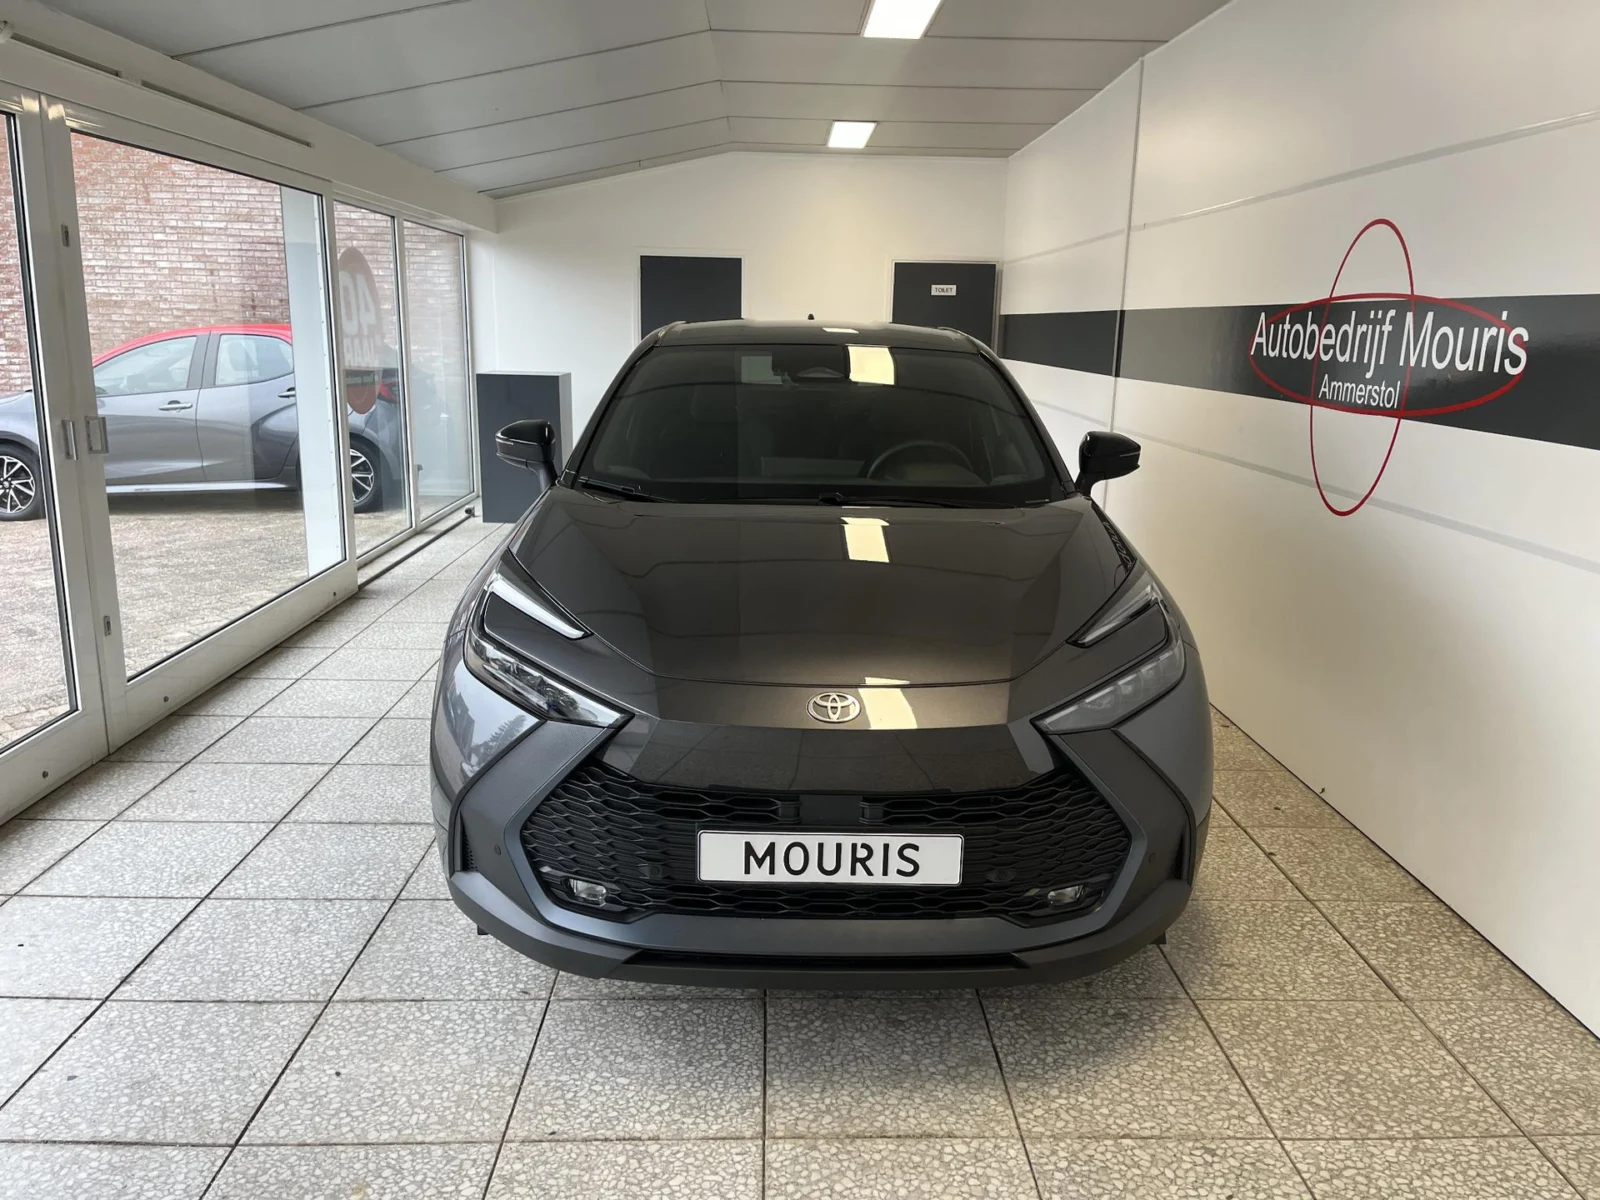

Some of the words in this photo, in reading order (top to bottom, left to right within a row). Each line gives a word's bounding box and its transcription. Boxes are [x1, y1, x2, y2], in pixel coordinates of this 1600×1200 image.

[1251, 309, 1396, 378] Autobedrijf
[1399, 310, 1529, 376] Mouris
[1318, 374, 1400, 408] Ammerstol
[744, 841, 920, 878] MOURIS
